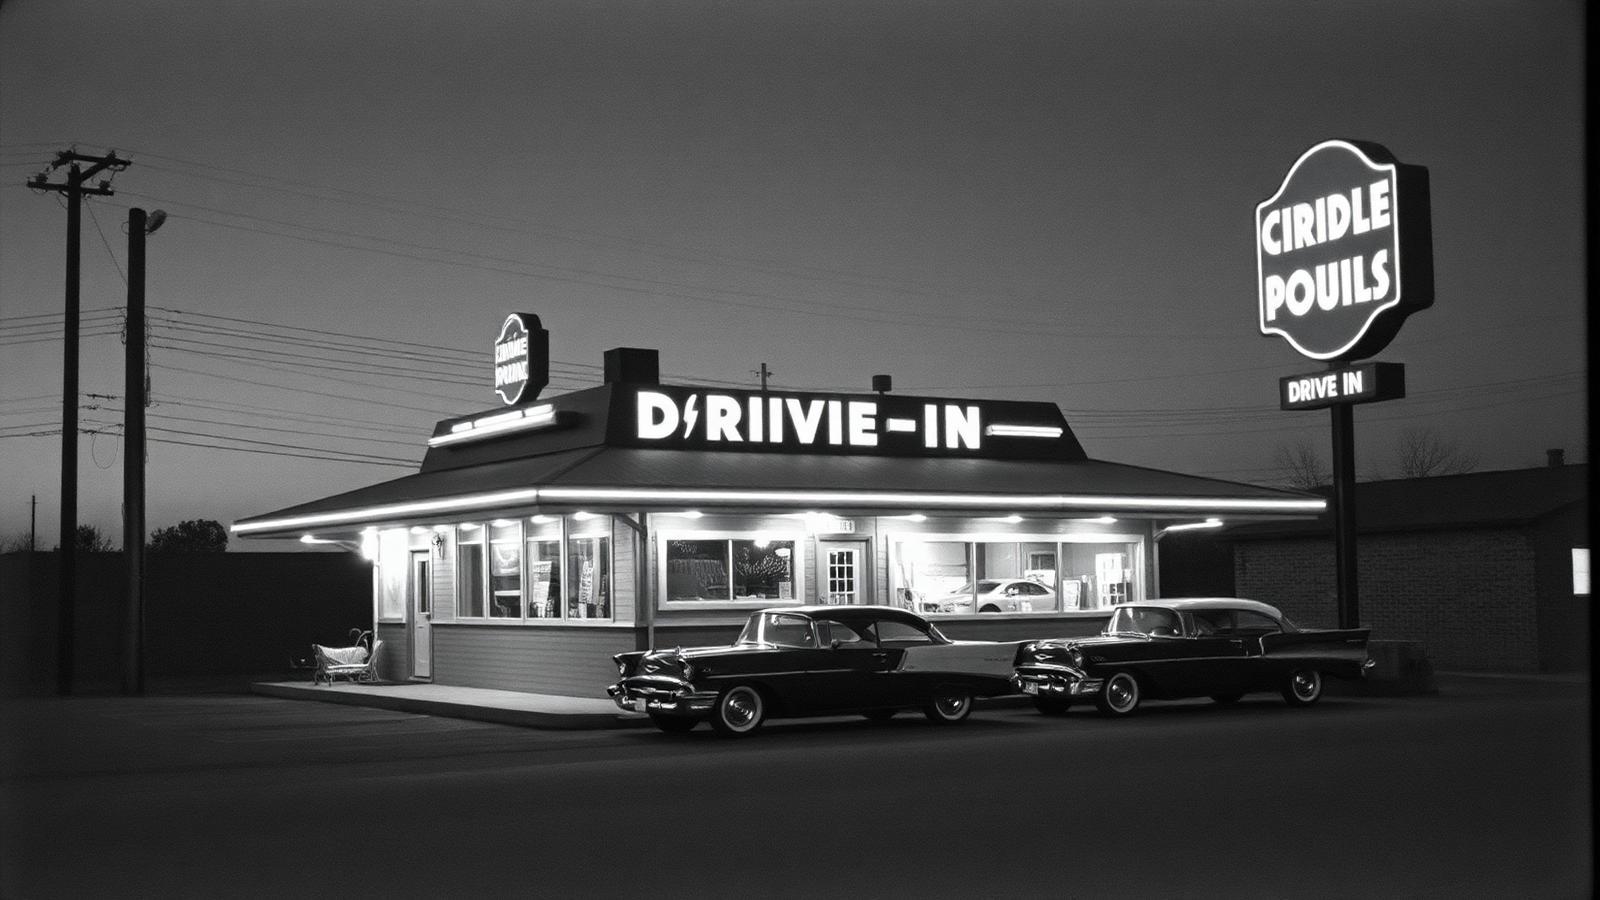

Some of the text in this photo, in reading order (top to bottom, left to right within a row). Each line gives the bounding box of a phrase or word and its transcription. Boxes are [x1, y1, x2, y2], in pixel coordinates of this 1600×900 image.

[1262, 178, 1391, 256] CIRIDLE
[1265, 249, 1391, 322] POUILS
[1289, 370, 1363, 403] DRIVE IN
